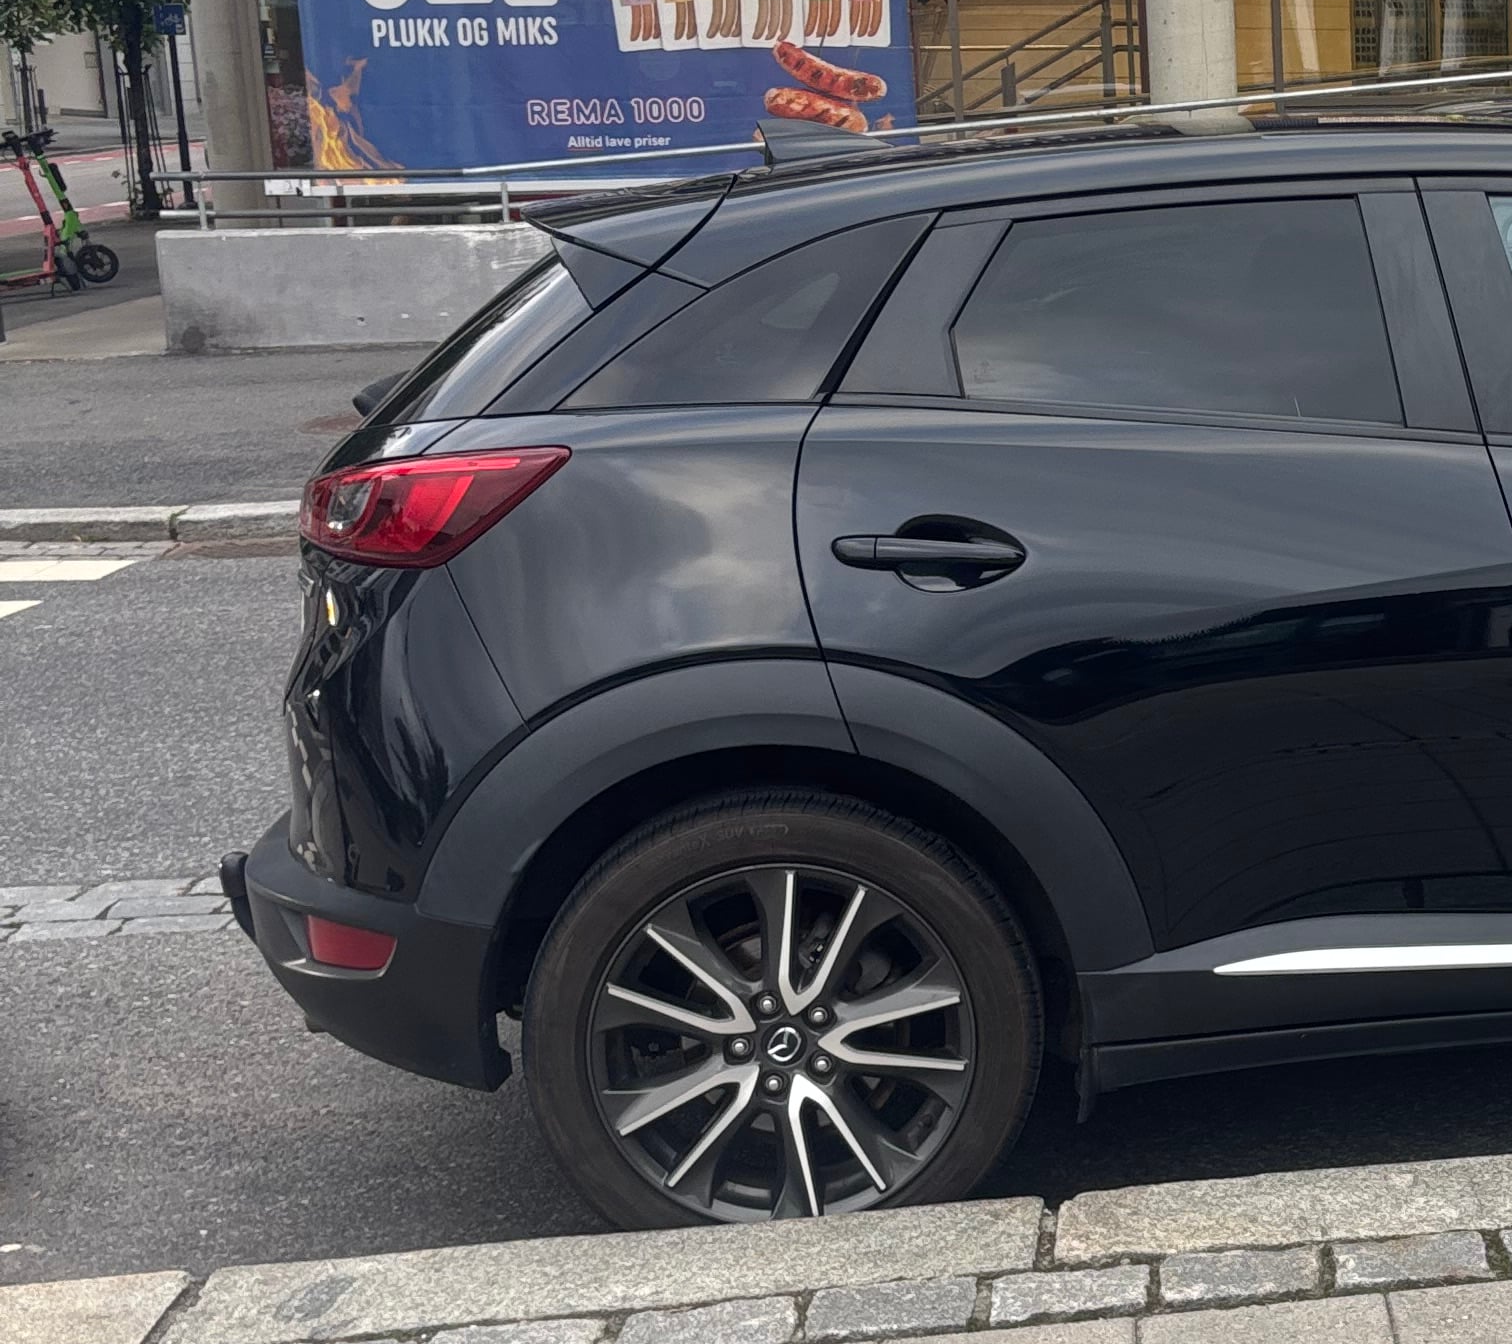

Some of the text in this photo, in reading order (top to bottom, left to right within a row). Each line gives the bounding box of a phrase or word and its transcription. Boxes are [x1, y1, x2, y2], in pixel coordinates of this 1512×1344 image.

[372, 16, 559, 47] PLUKK OG MIKS
[527, 96, 705, 126] REMA 1000
[567, 135, 671, 148] Alltid lave priser
